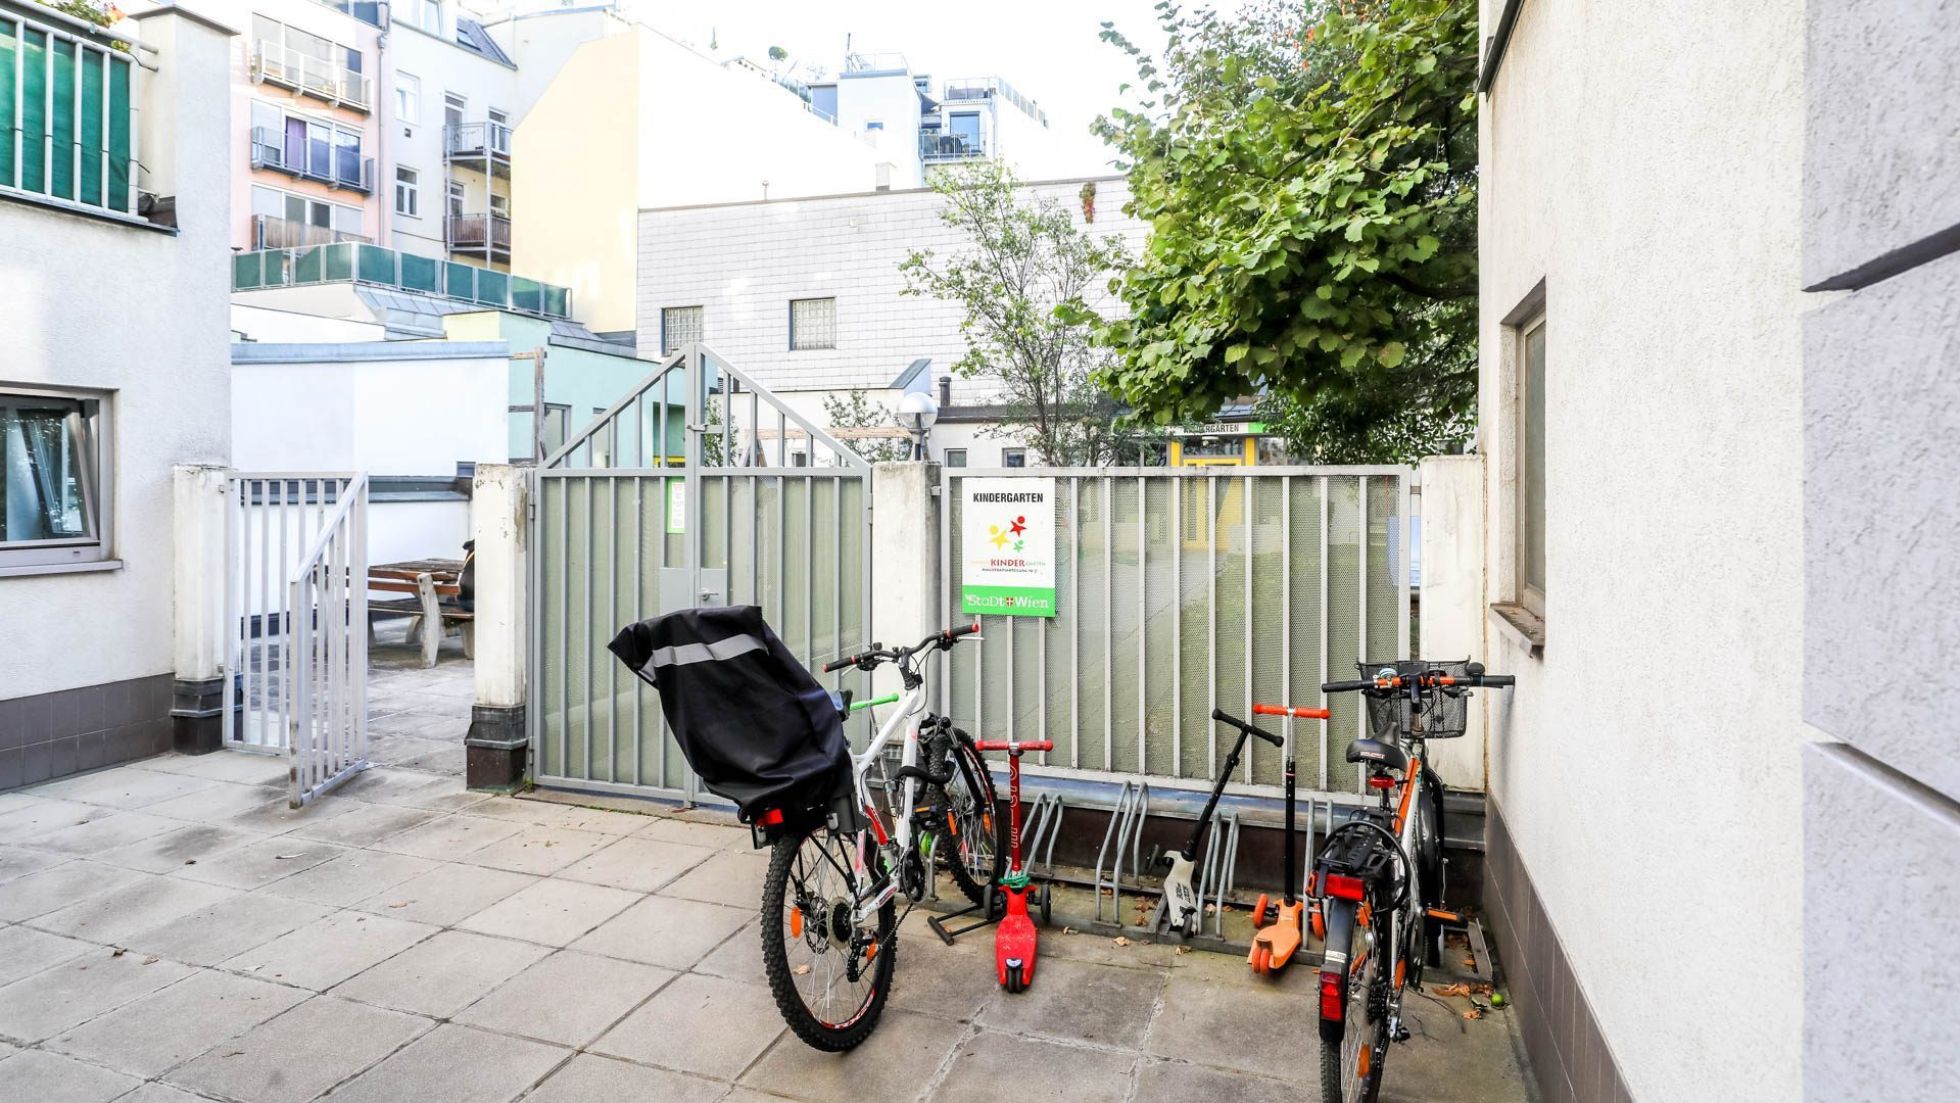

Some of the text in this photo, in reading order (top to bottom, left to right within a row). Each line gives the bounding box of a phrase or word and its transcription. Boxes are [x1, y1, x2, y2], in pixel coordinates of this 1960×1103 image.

[973, 492, 1043, 503] KINDERGARTEN
[990, 559, 1025, 567] KINDER
[1015, 596, 1049, 609] Wien
